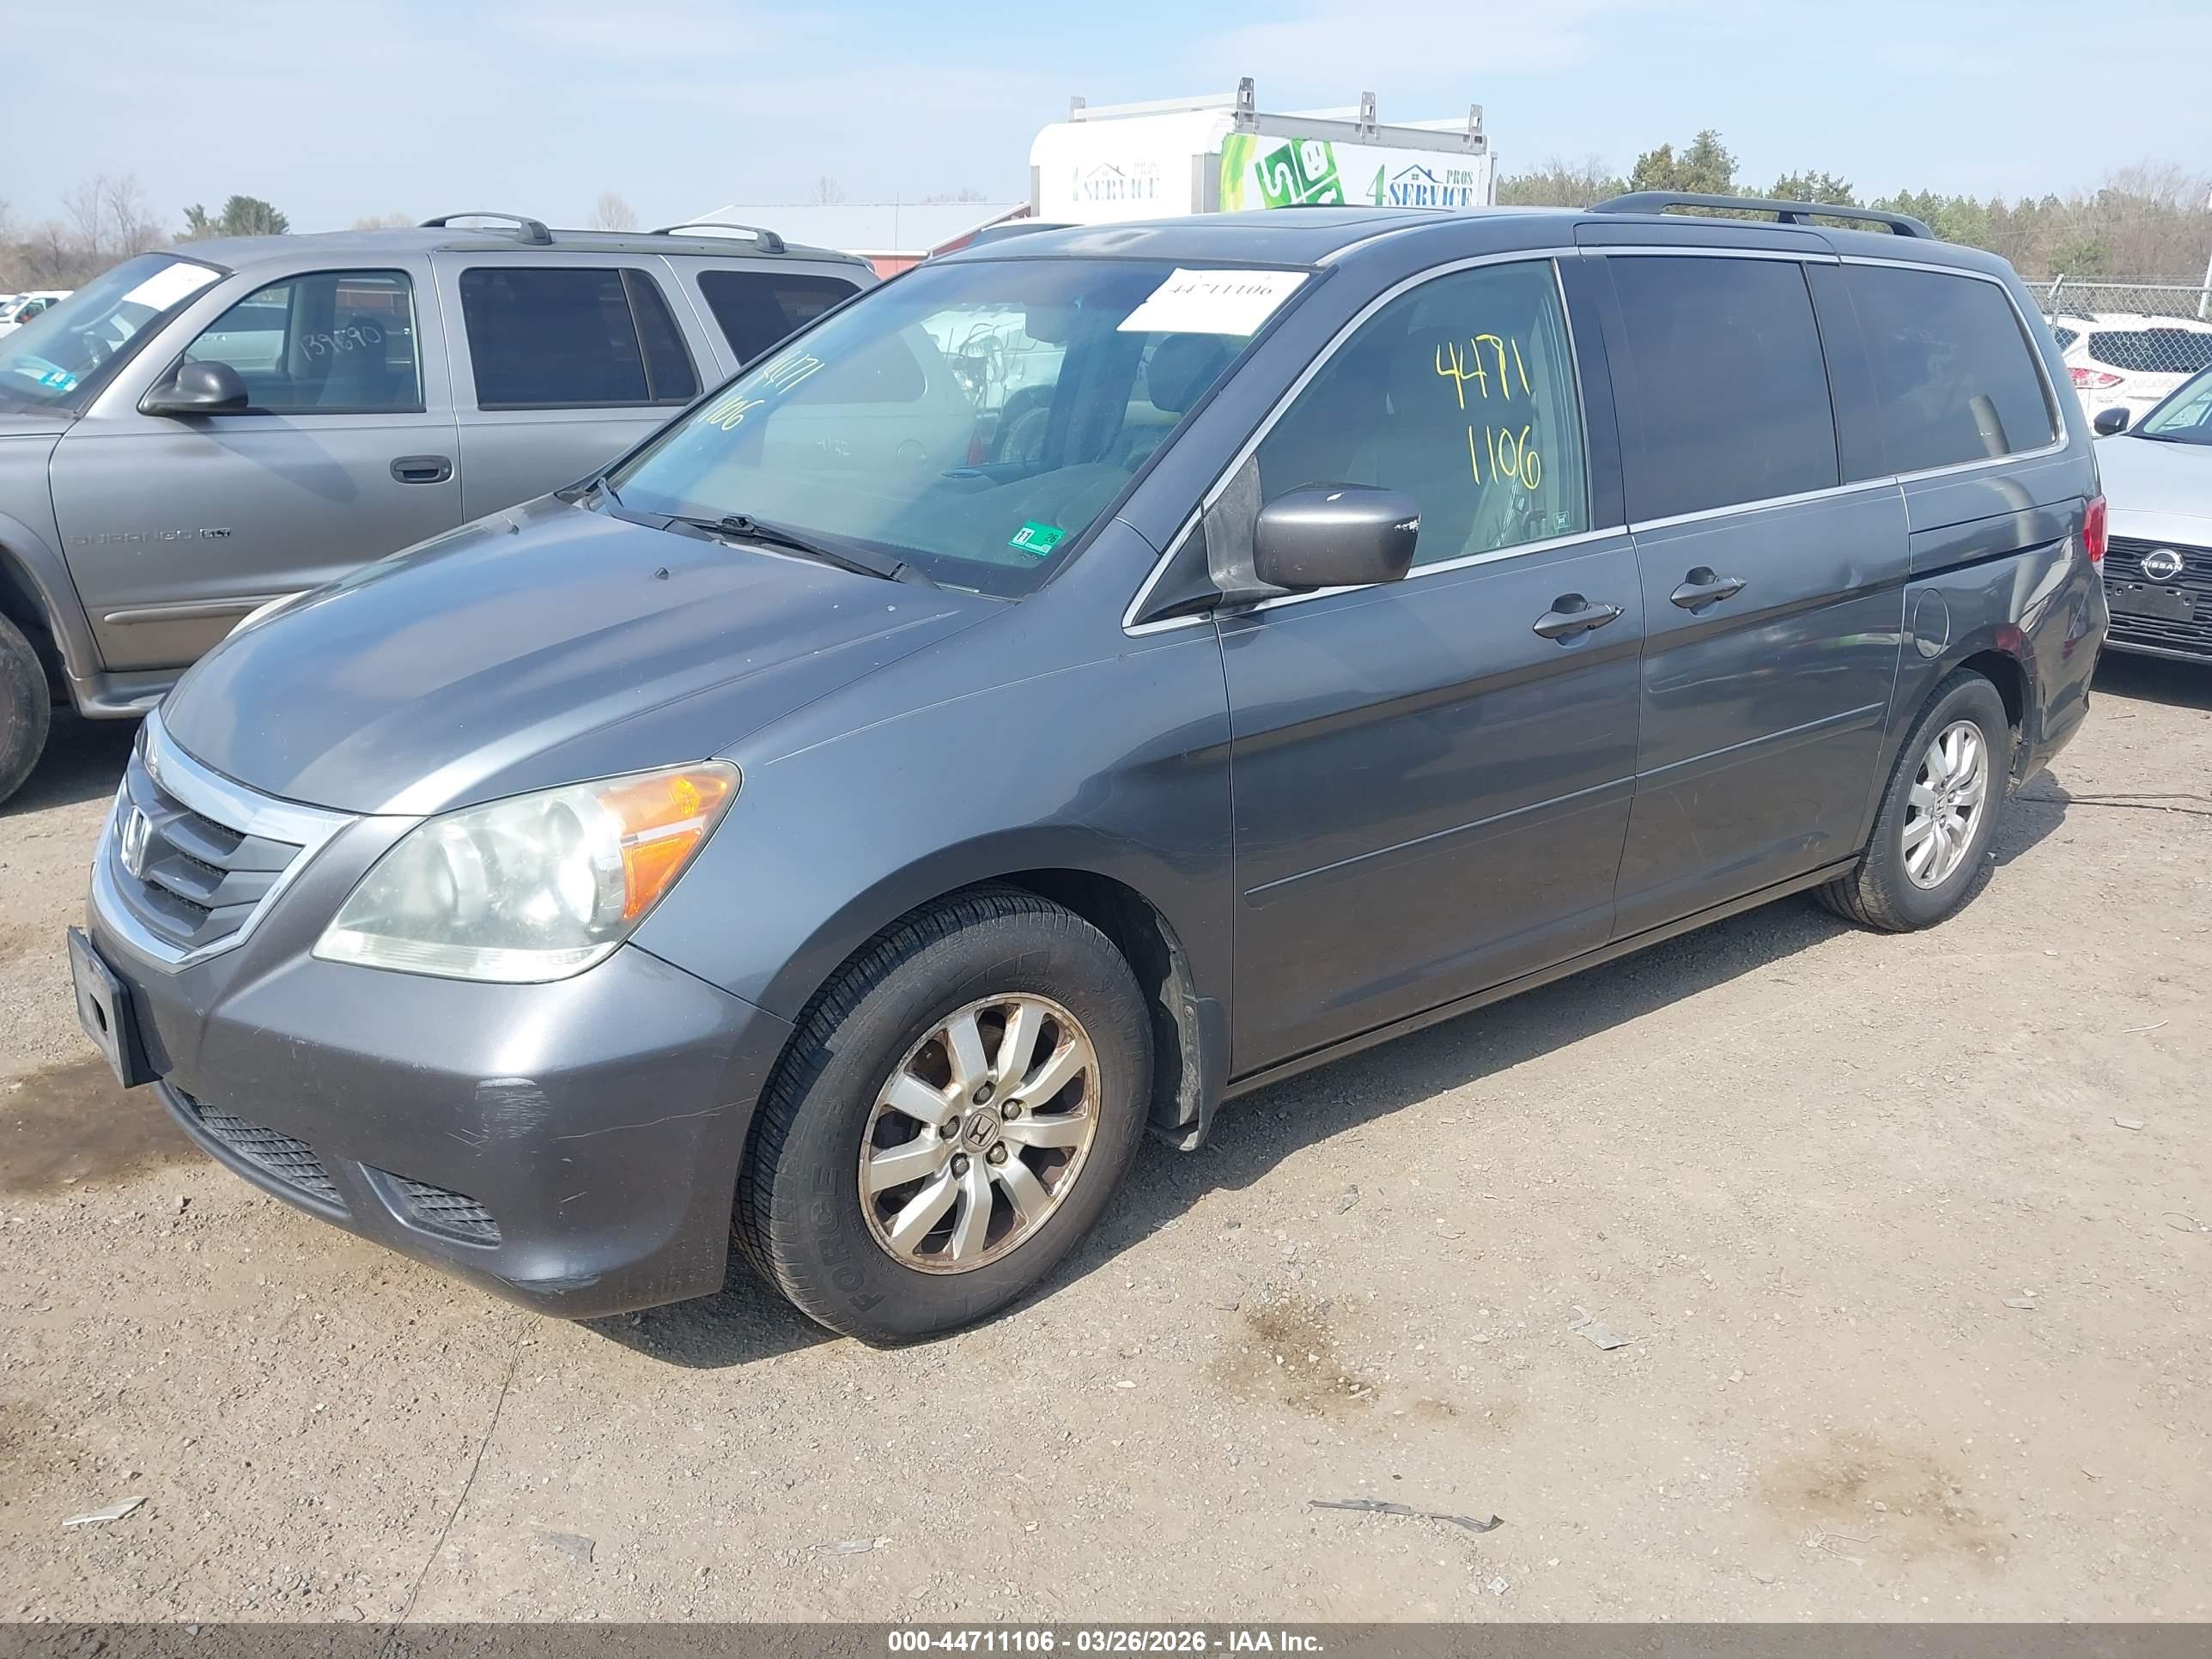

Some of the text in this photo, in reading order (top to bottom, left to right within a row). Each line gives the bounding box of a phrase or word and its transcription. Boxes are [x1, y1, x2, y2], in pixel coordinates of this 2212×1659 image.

[1365, 163, 1474, 206] 4 SERVICE
[1446, 169, 1474, 185] PROS
[1436, 333, 1531, 410] 4471
[1468, 425, 1541, 489] 1106
[1016, 530, 1059, 544] 11 26
[2140, 559, 2184, 571] NISSAN
[810, 1165, 886, 1313] FORCE
